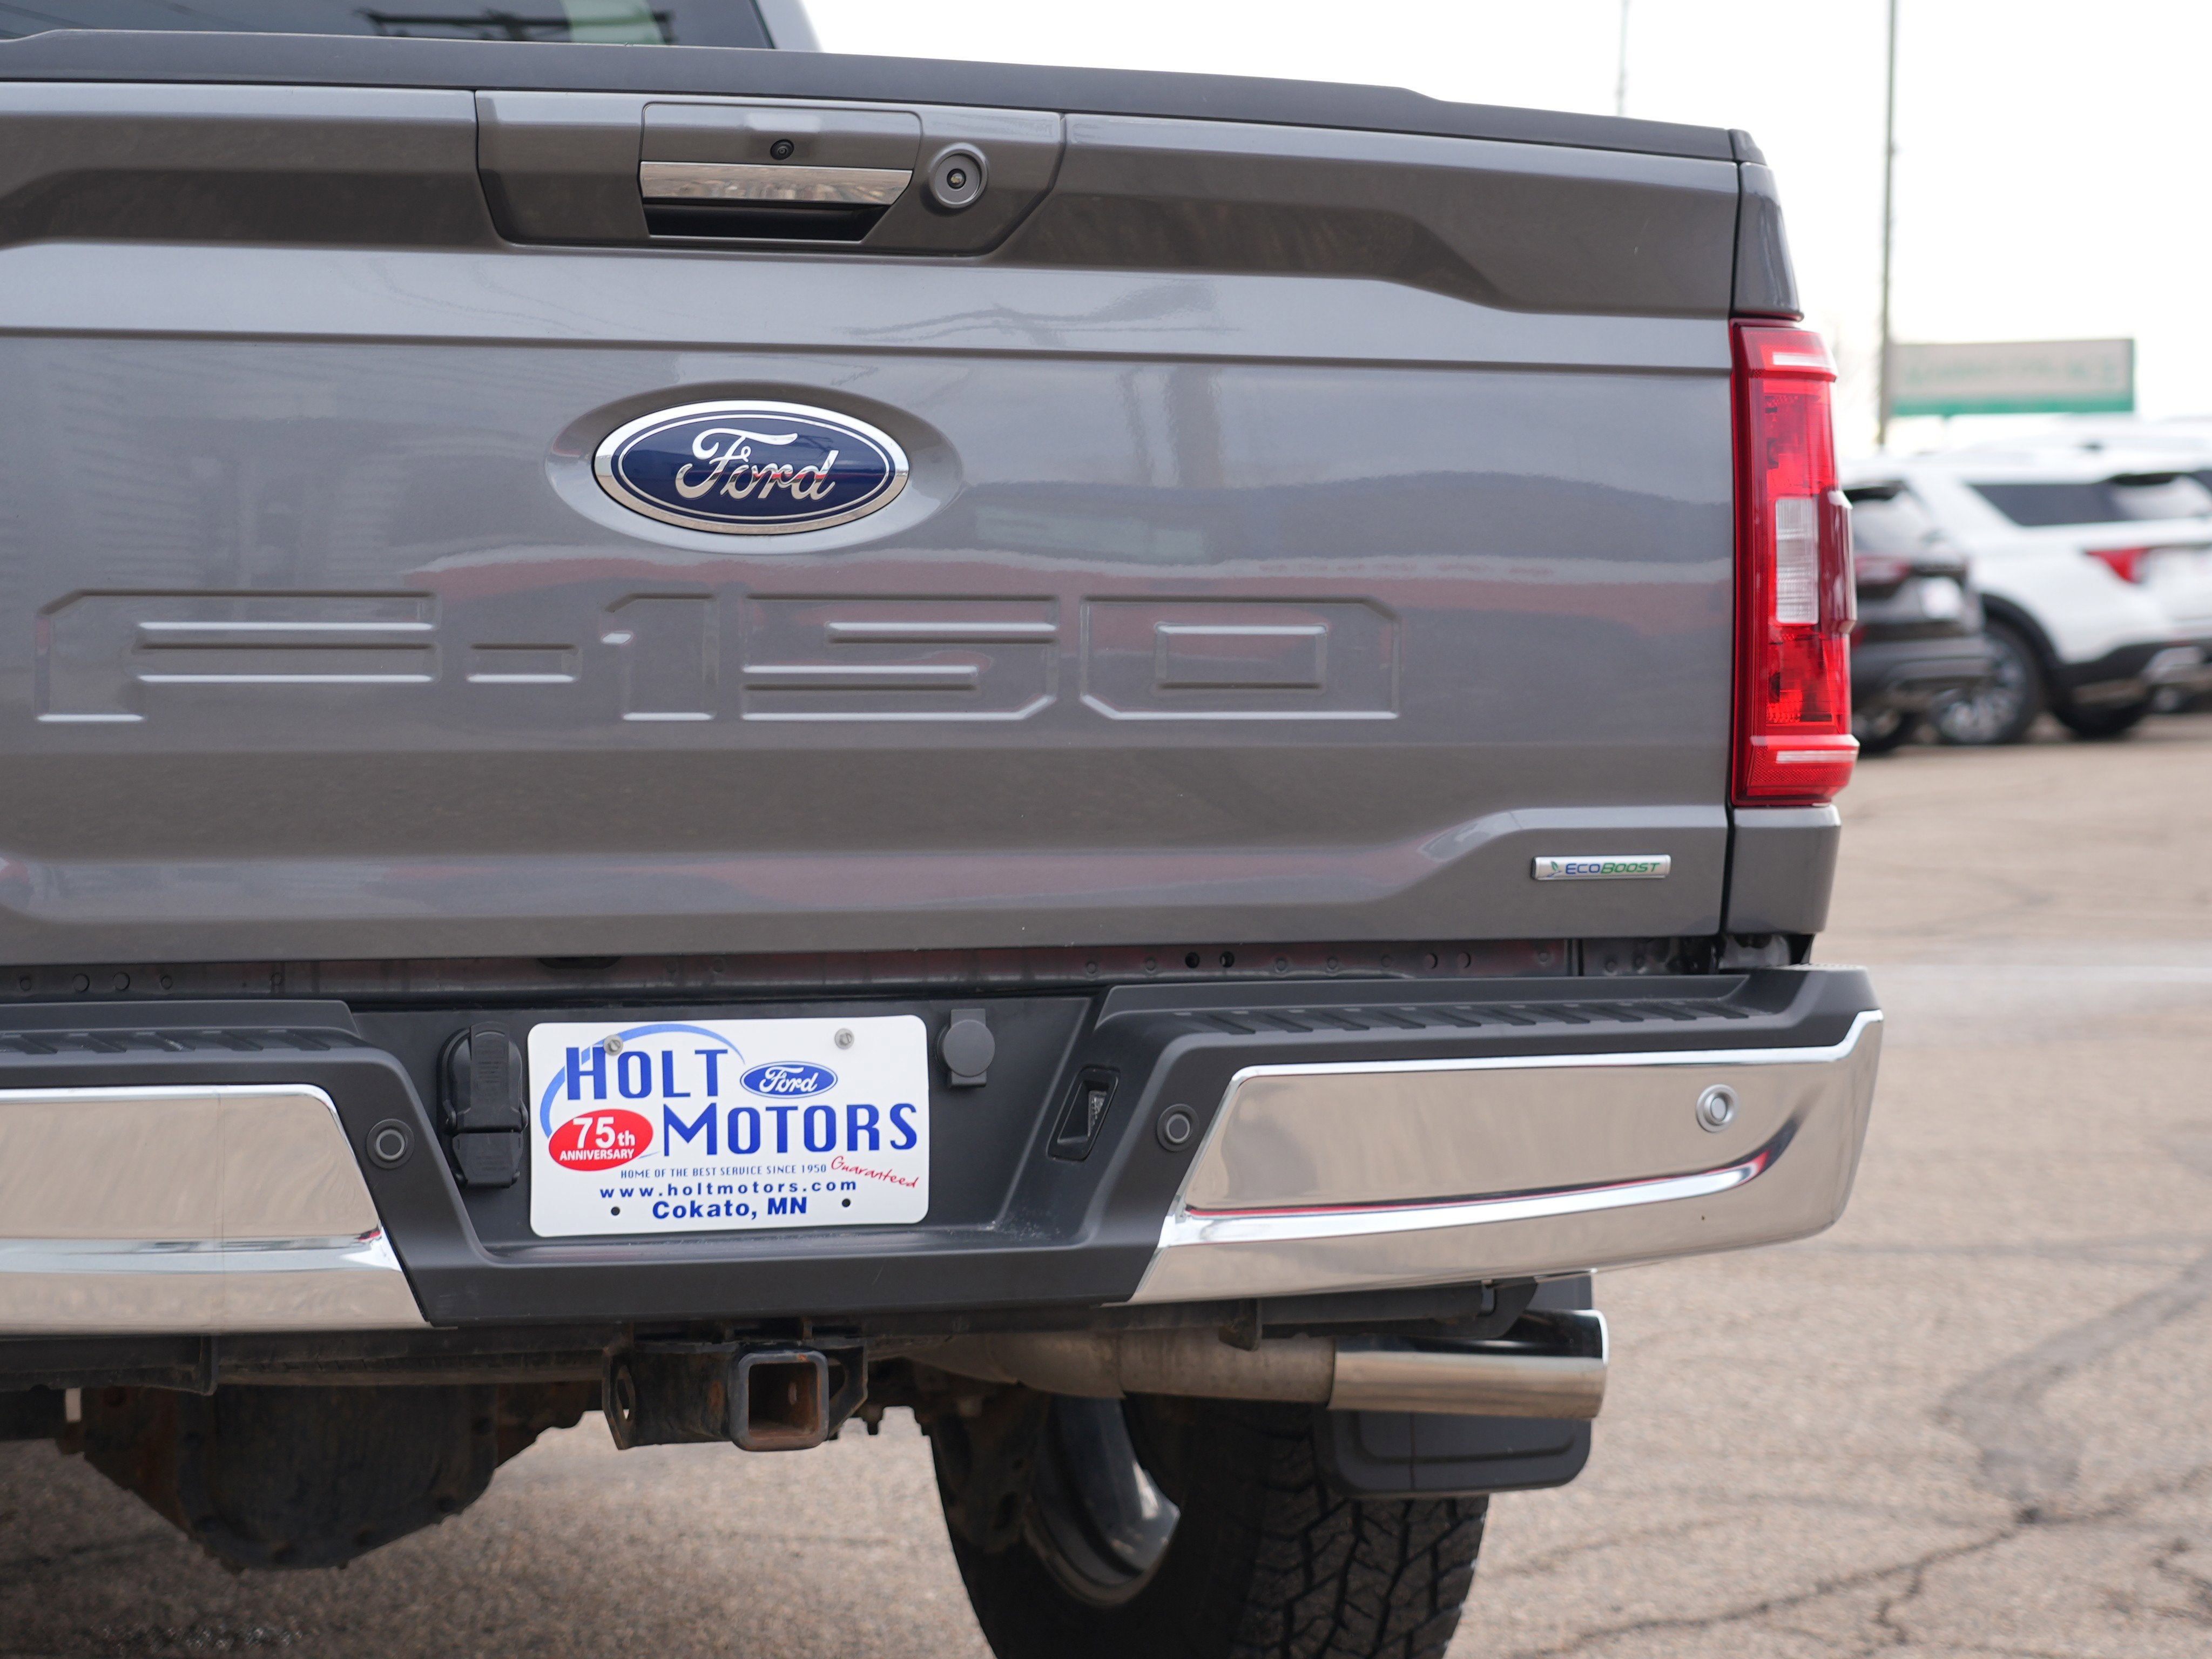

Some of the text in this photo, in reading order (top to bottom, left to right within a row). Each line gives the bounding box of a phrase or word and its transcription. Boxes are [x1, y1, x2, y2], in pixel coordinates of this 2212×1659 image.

[675, 428, 839, 500] Ford
[35, 589, 1400, 724] F-150
[1566, 862, 1660, 875] ECOBOOST
[565, 1046, 729, 1100] HOLT
[759, 1065, 819, 1093] Ford
[572, 1116, 636, 1149] 75th
[663, 1102, 918, 1157] MOTORS
[559, 1148, 635, 1162] ANNIVERSARY
[620, 1164, 827, 1179] HOME OF THE BEST SERVICE SINCE 1950
[831, 1155, 920, 1188] Guaranteed
[599, 1180, 857, 1198] www.holtmotors.com
[652, 1196, 807, 1220] Cokato, MN
